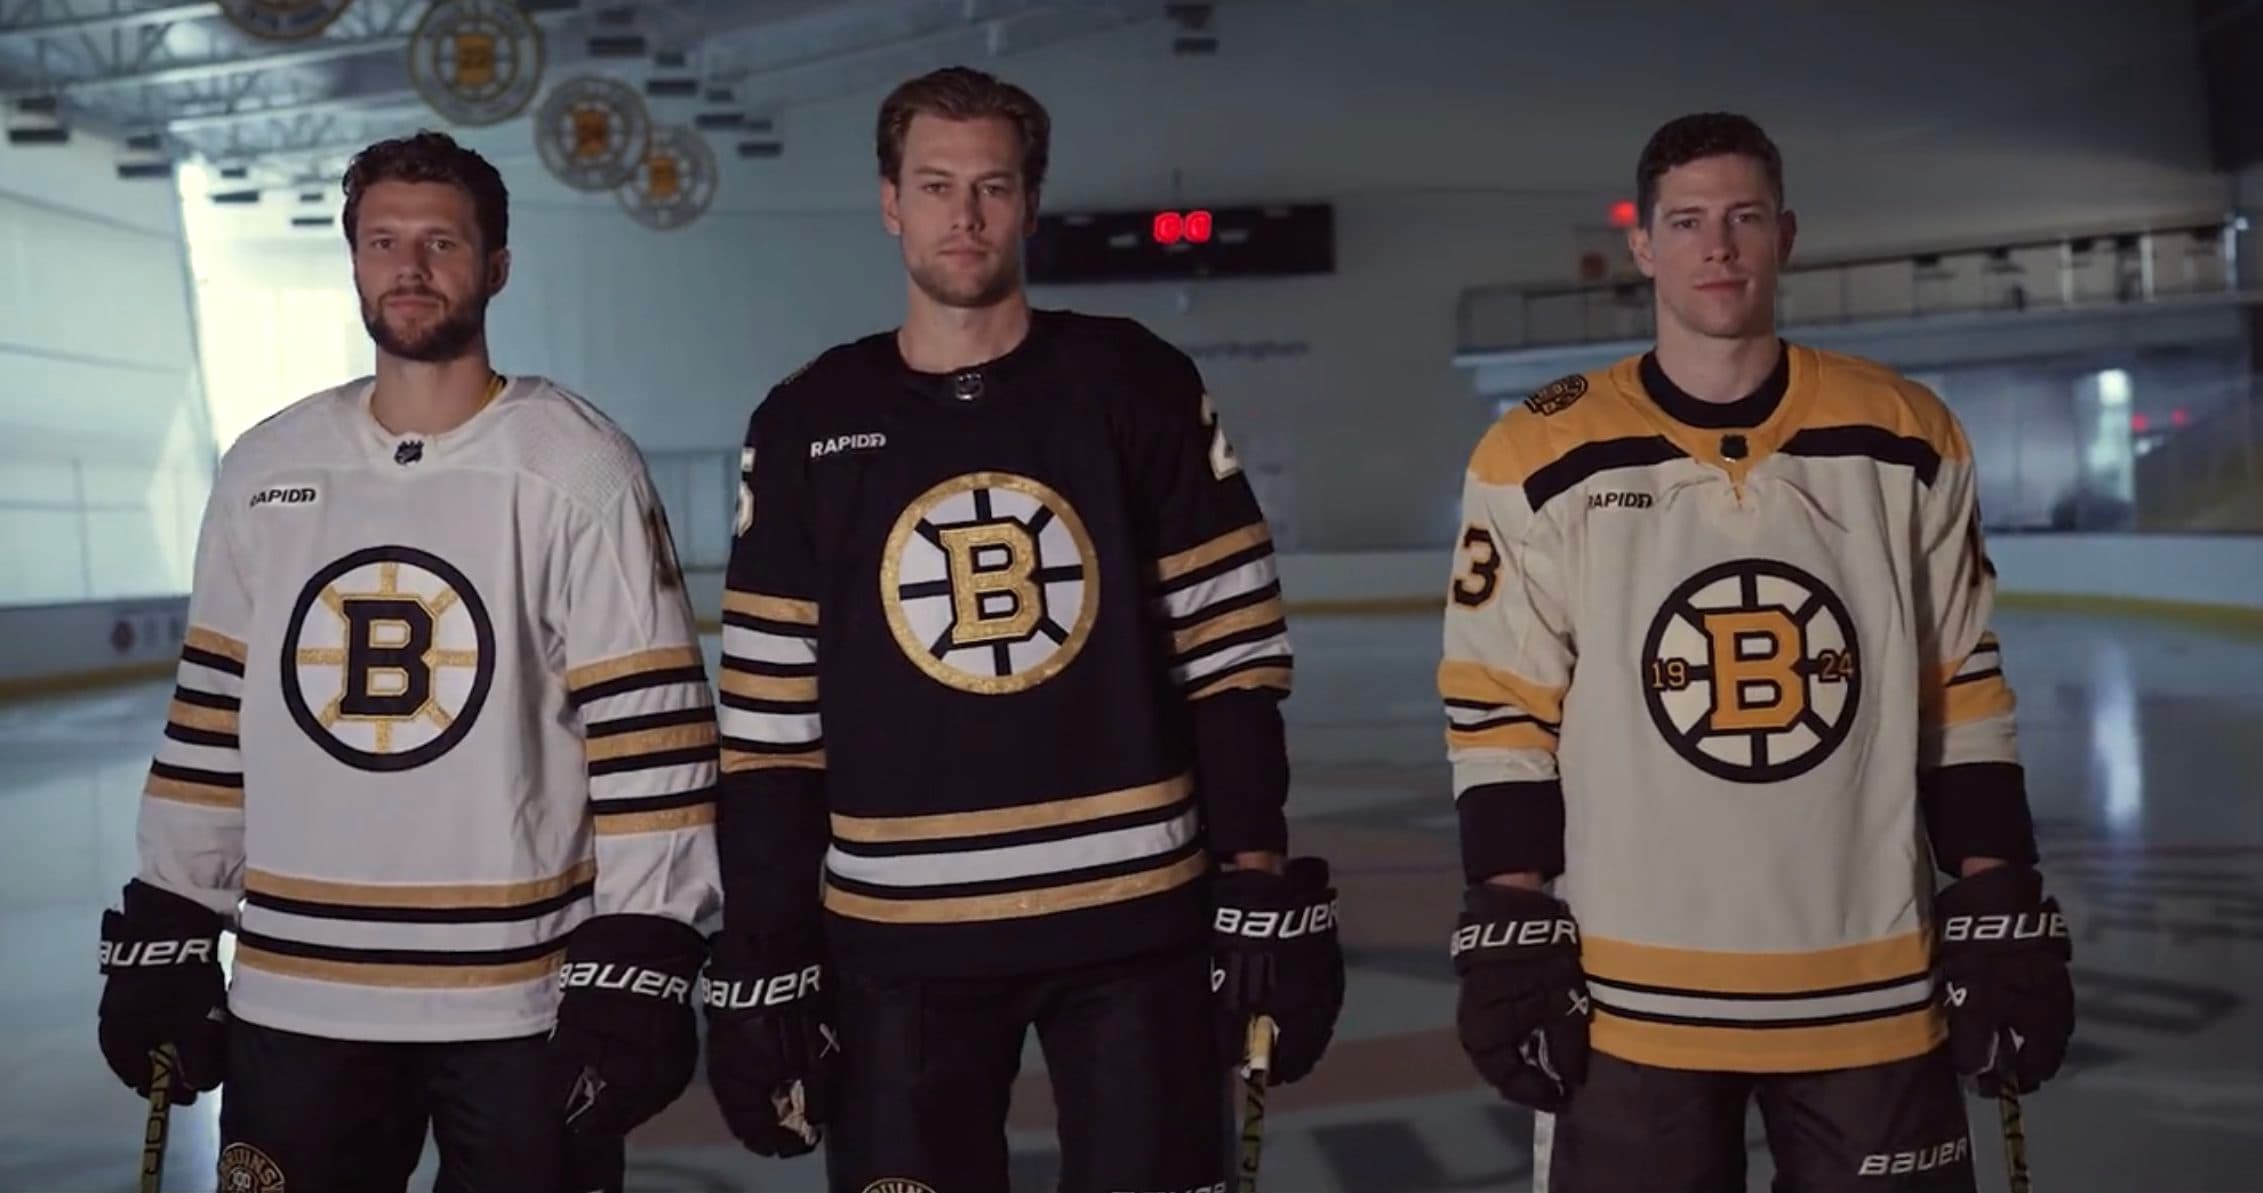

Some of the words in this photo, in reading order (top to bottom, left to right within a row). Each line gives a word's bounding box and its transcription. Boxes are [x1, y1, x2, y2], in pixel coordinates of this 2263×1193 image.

[939, 518, 1044, 647] B
[1452, 524, 1501, 607] 3
[340, 595, 438, 719] B
[1651, 659, 1688, 690] 19
[1703, 605, 1806, 735] B
[1819, 650, 1854, 684] 24
[100, 939, 211, 966] AUER
[1944, 912, 2069, 941] BAUE
[1858, 1136, 1968, 1176] BAUER
